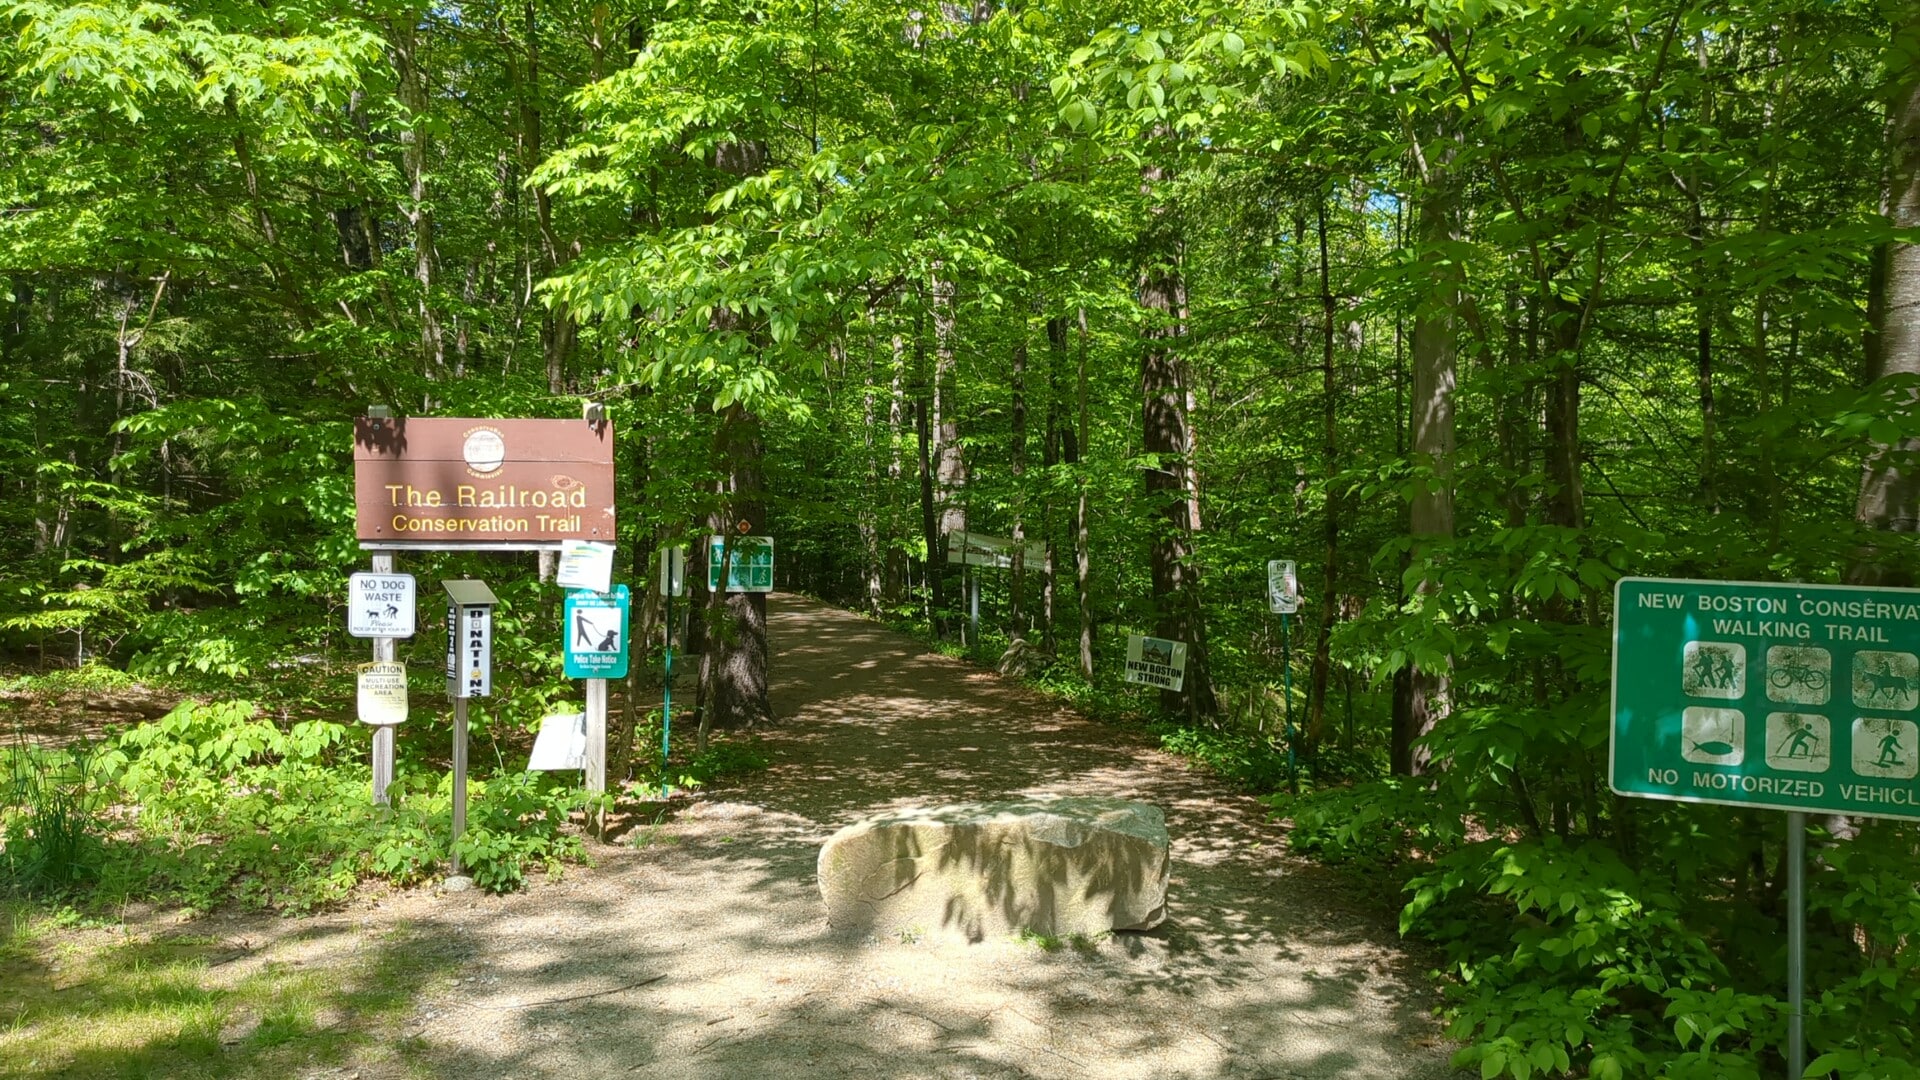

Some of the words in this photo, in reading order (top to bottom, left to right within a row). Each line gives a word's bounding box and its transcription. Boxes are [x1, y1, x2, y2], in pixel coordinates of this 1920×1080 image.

[385, 485, 442, 507] The
[457, 484, 586, 507] Railroad
[392, 515, 529, 532] Conservation
[535, 515, 581, 532] Trail
[360, 579, 377, 589] NO
[381, 580, 406, 590] DOG
[364, 592, 402, 602] WASTE
[1637, 592, 1685, 610] NEW
[1698, 595, 1788, 615] BOSTON
[1799, 599, 1920, 620] CONSERVA
[1712, 619, 1811, 639] WALKING
[1824, 624, 1889, 643] TRAIL
[362, 665, 402, 674] CAUTION
[1127, 660, 1149, 671] NEW
[1149, 663, 1182, 678] BOSTON
[1137, 672, 1171, 686] STRONG
[1647, 767, 1680, 785] NO
[1692, 771, 1825, 798] MOTORIZED
